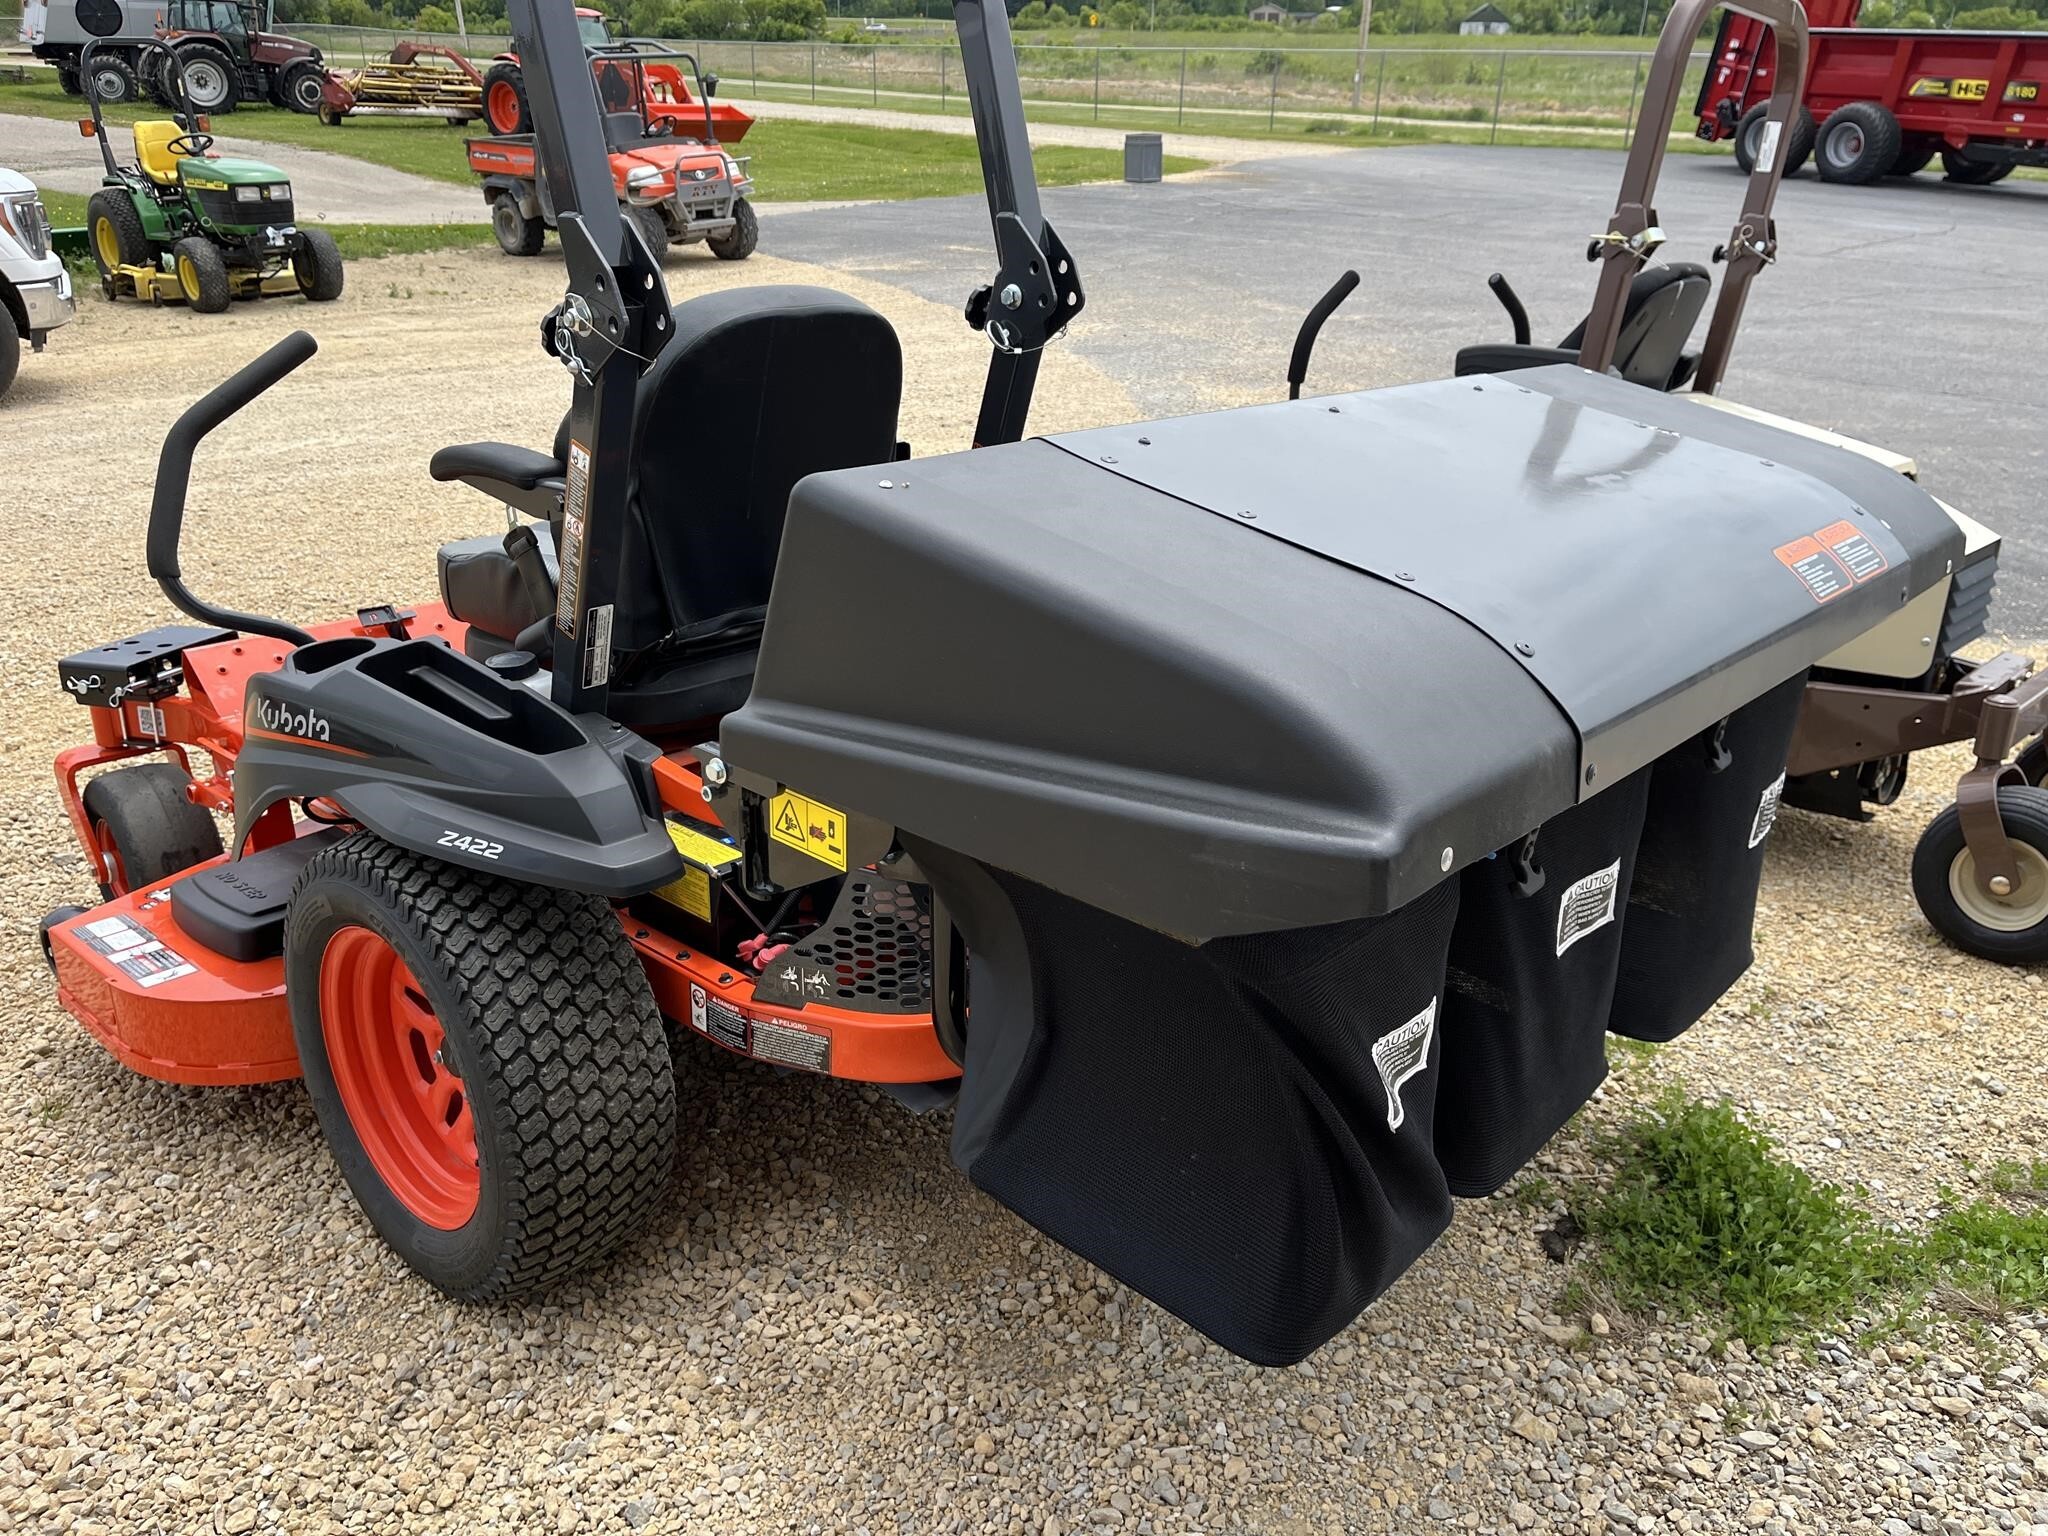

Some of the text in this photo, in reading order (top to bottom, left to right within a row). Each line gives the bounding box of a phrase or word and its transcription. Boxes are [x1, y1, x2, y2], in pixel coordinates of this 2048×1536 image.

[257, 697, 330, 742] Kubota
[436, 830, 504, 859] Z422
[215, 871, 268, 899] NO STEP
[1574, 870, 1615, 895] CAUTION
[717, 998, 740, 1013] DANGER
[778, 1019, 808, 1031] PELIGRO
[1375, 1015, 1427, 1057] CAUTION
